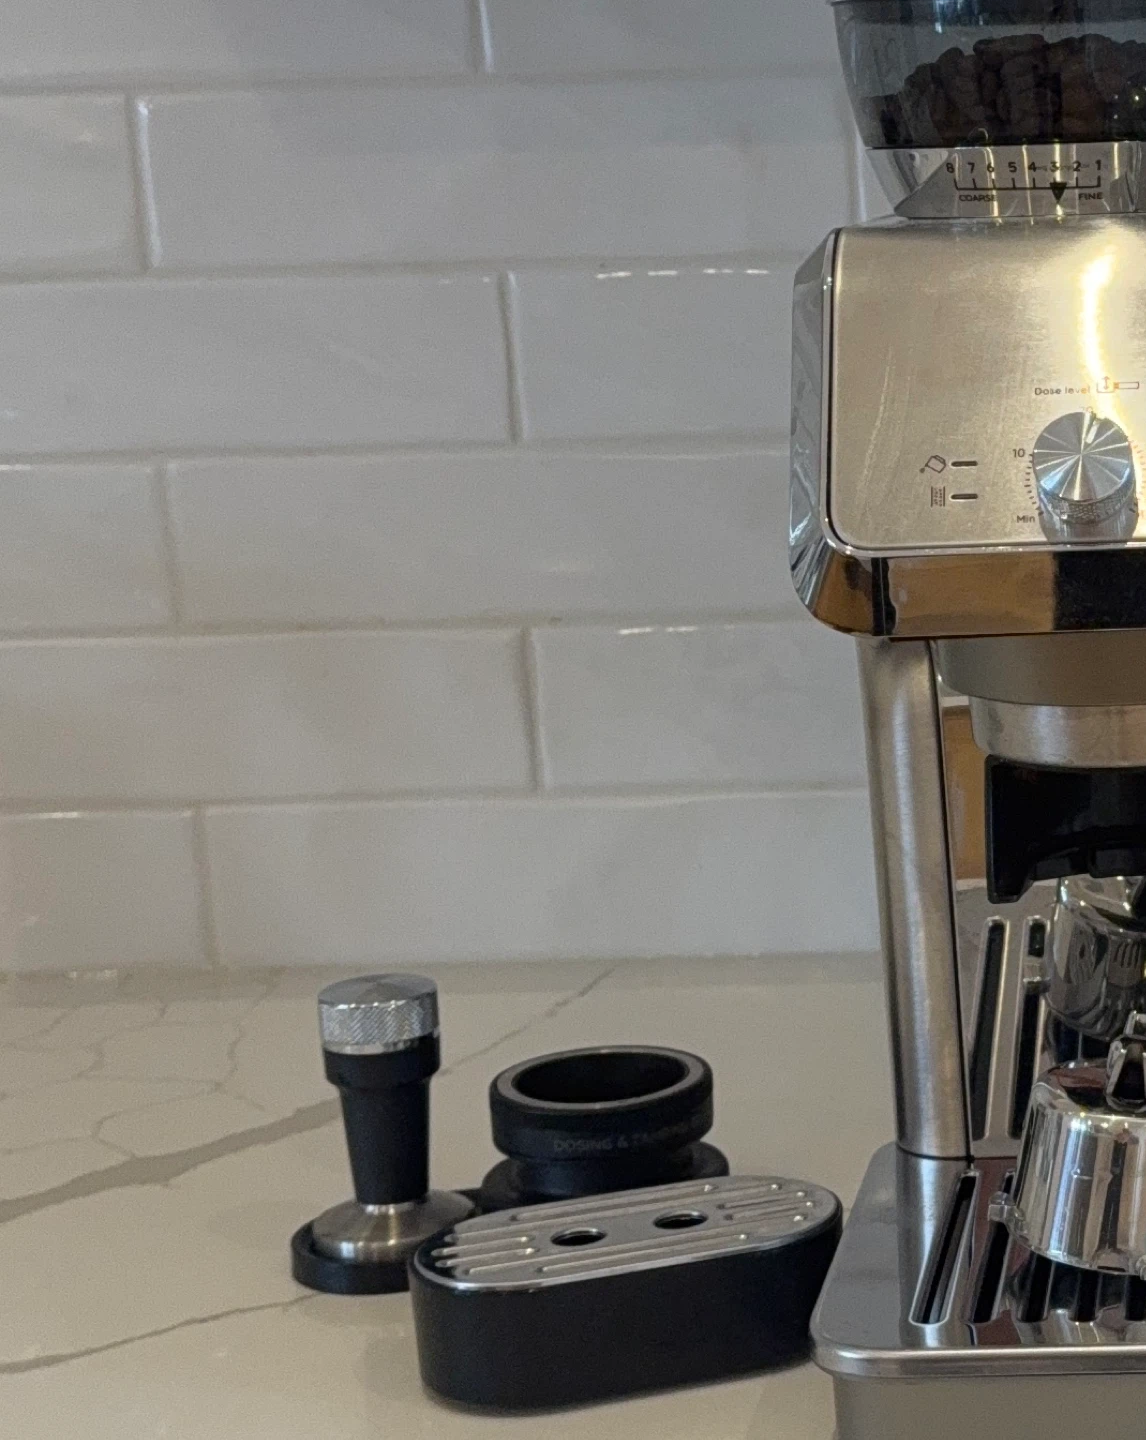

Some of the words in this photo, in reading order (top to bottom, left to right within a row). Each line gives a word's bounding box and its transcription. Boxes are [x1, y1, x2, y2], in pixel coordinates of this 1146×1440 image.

[946, 162, 955, 173] 8
[967, 162, 975, 173] 7
[986, 162, 995, 173] 6
[1008, 161, 1017, 173] 5
[1028, 161, 1037, 172] 4
[1050, 161, 1060, 172] 3
[1073, 161, 1081, 172] 2
[958, 193, 997, 202] COARSE
[1078, 191, 1103, 200] FINE
[1034, 387, 1061, 396] Dose
[1064, 385, 1091, 395] level
[1012, 448, 1025, 458] 10
[1016, 514, 1035, 524] Min
